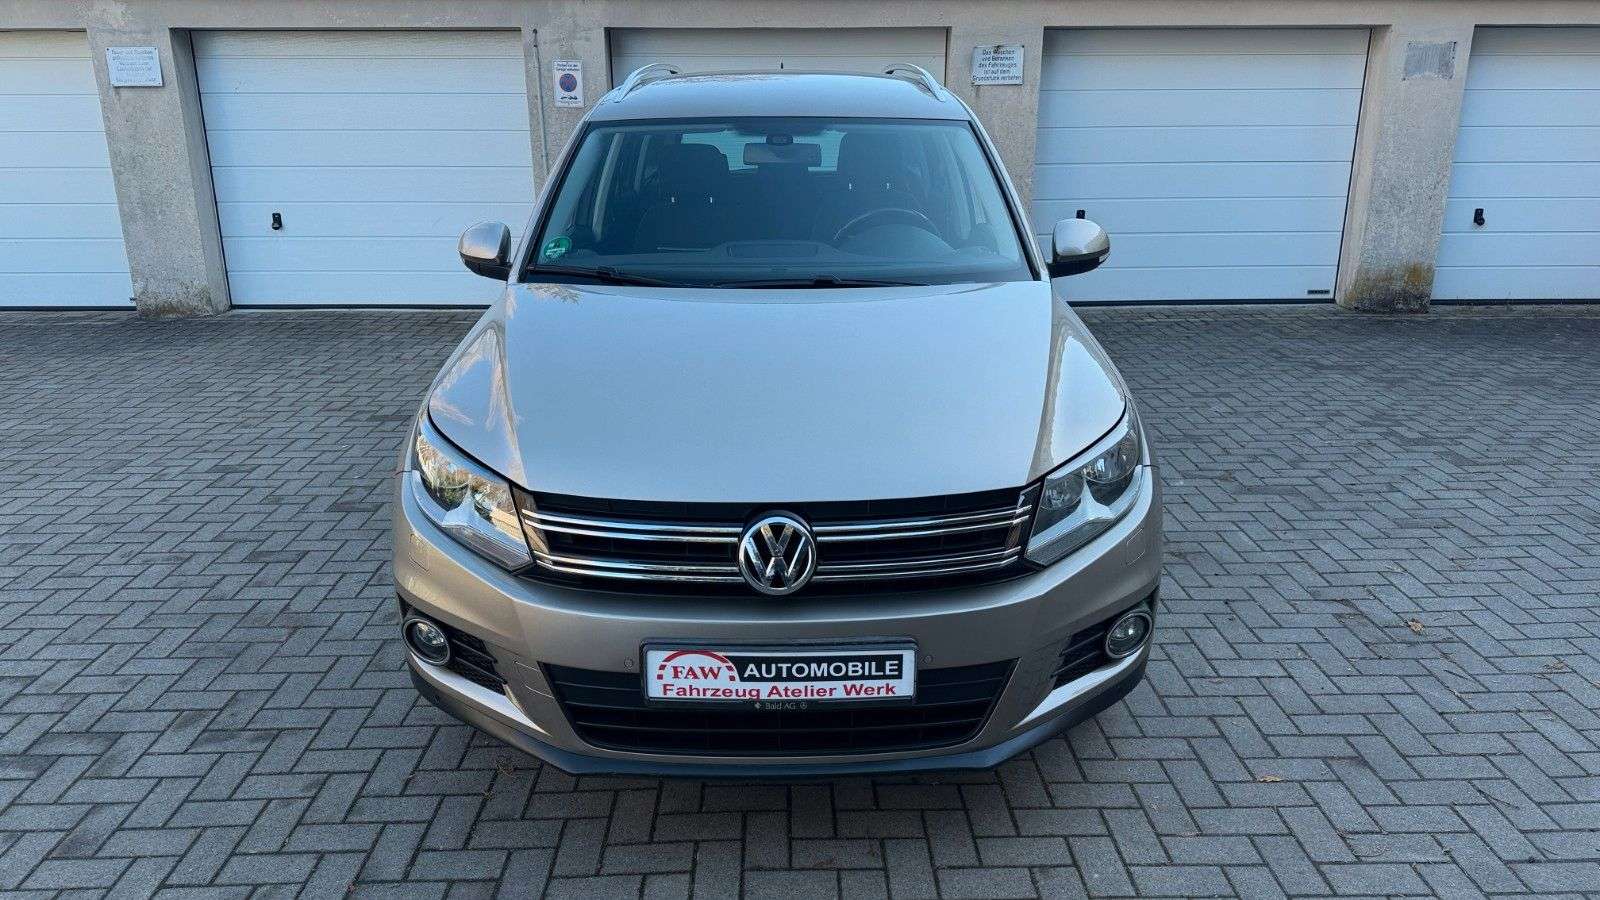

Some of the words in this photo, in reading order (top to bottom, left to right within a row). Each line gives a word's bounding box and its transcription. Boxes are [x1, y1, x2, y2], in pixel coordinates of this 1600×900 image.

[671, 665, 721, 680] FAW
[743, 660, 899, 678] AUTOMOBILE
[662, 683, 761, 700] Fahrzeug
[767, 684, 837, 698] Atelier
[843, 682, 897, 696] Werk
[783, 702, 796, 710] AG
